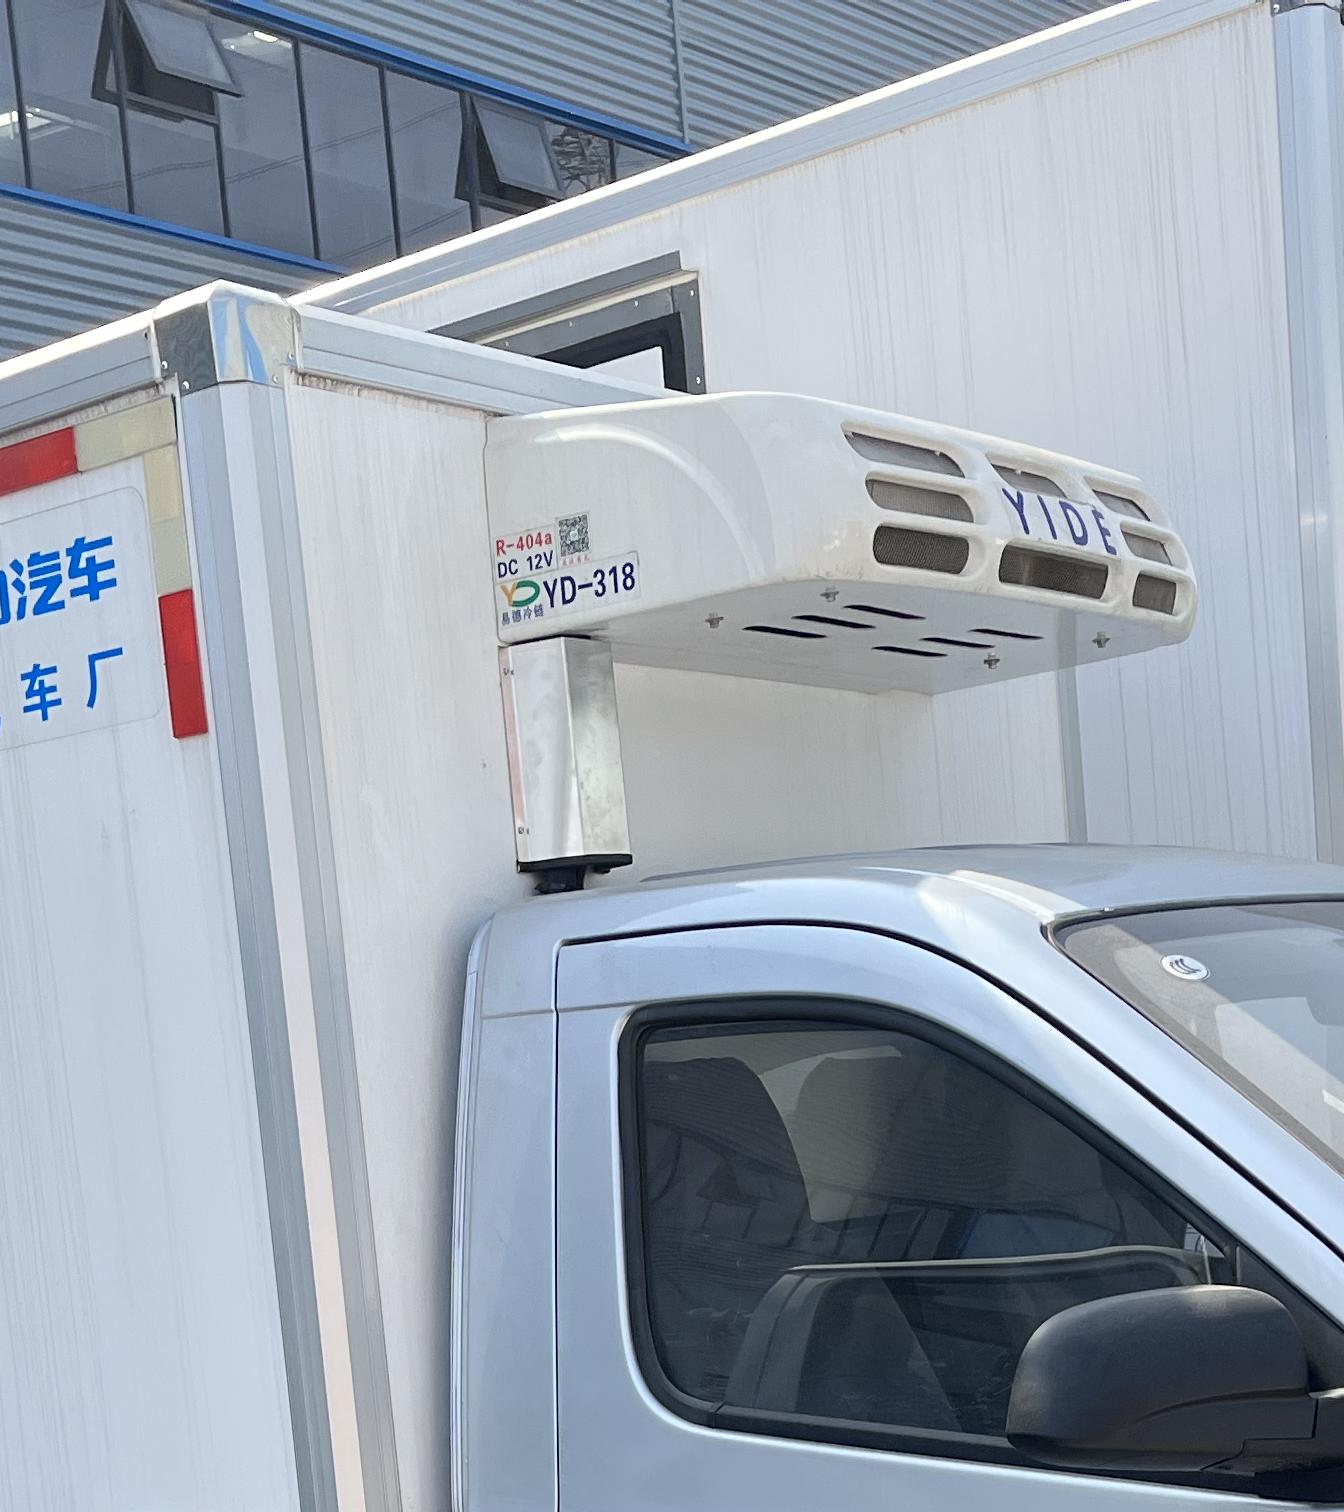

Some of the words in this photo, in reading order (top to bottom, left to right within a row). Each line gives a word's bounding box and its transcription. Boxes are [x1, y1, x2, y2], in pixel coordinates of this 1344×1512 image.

[1001, 487, 1118, 556] YIDE
[495, 531, 553, 557] R-404a
[497, 559, 519, 579] DC
[526, 550, 554, 572] 12V
[542, 561, 636, 609] YD-318
